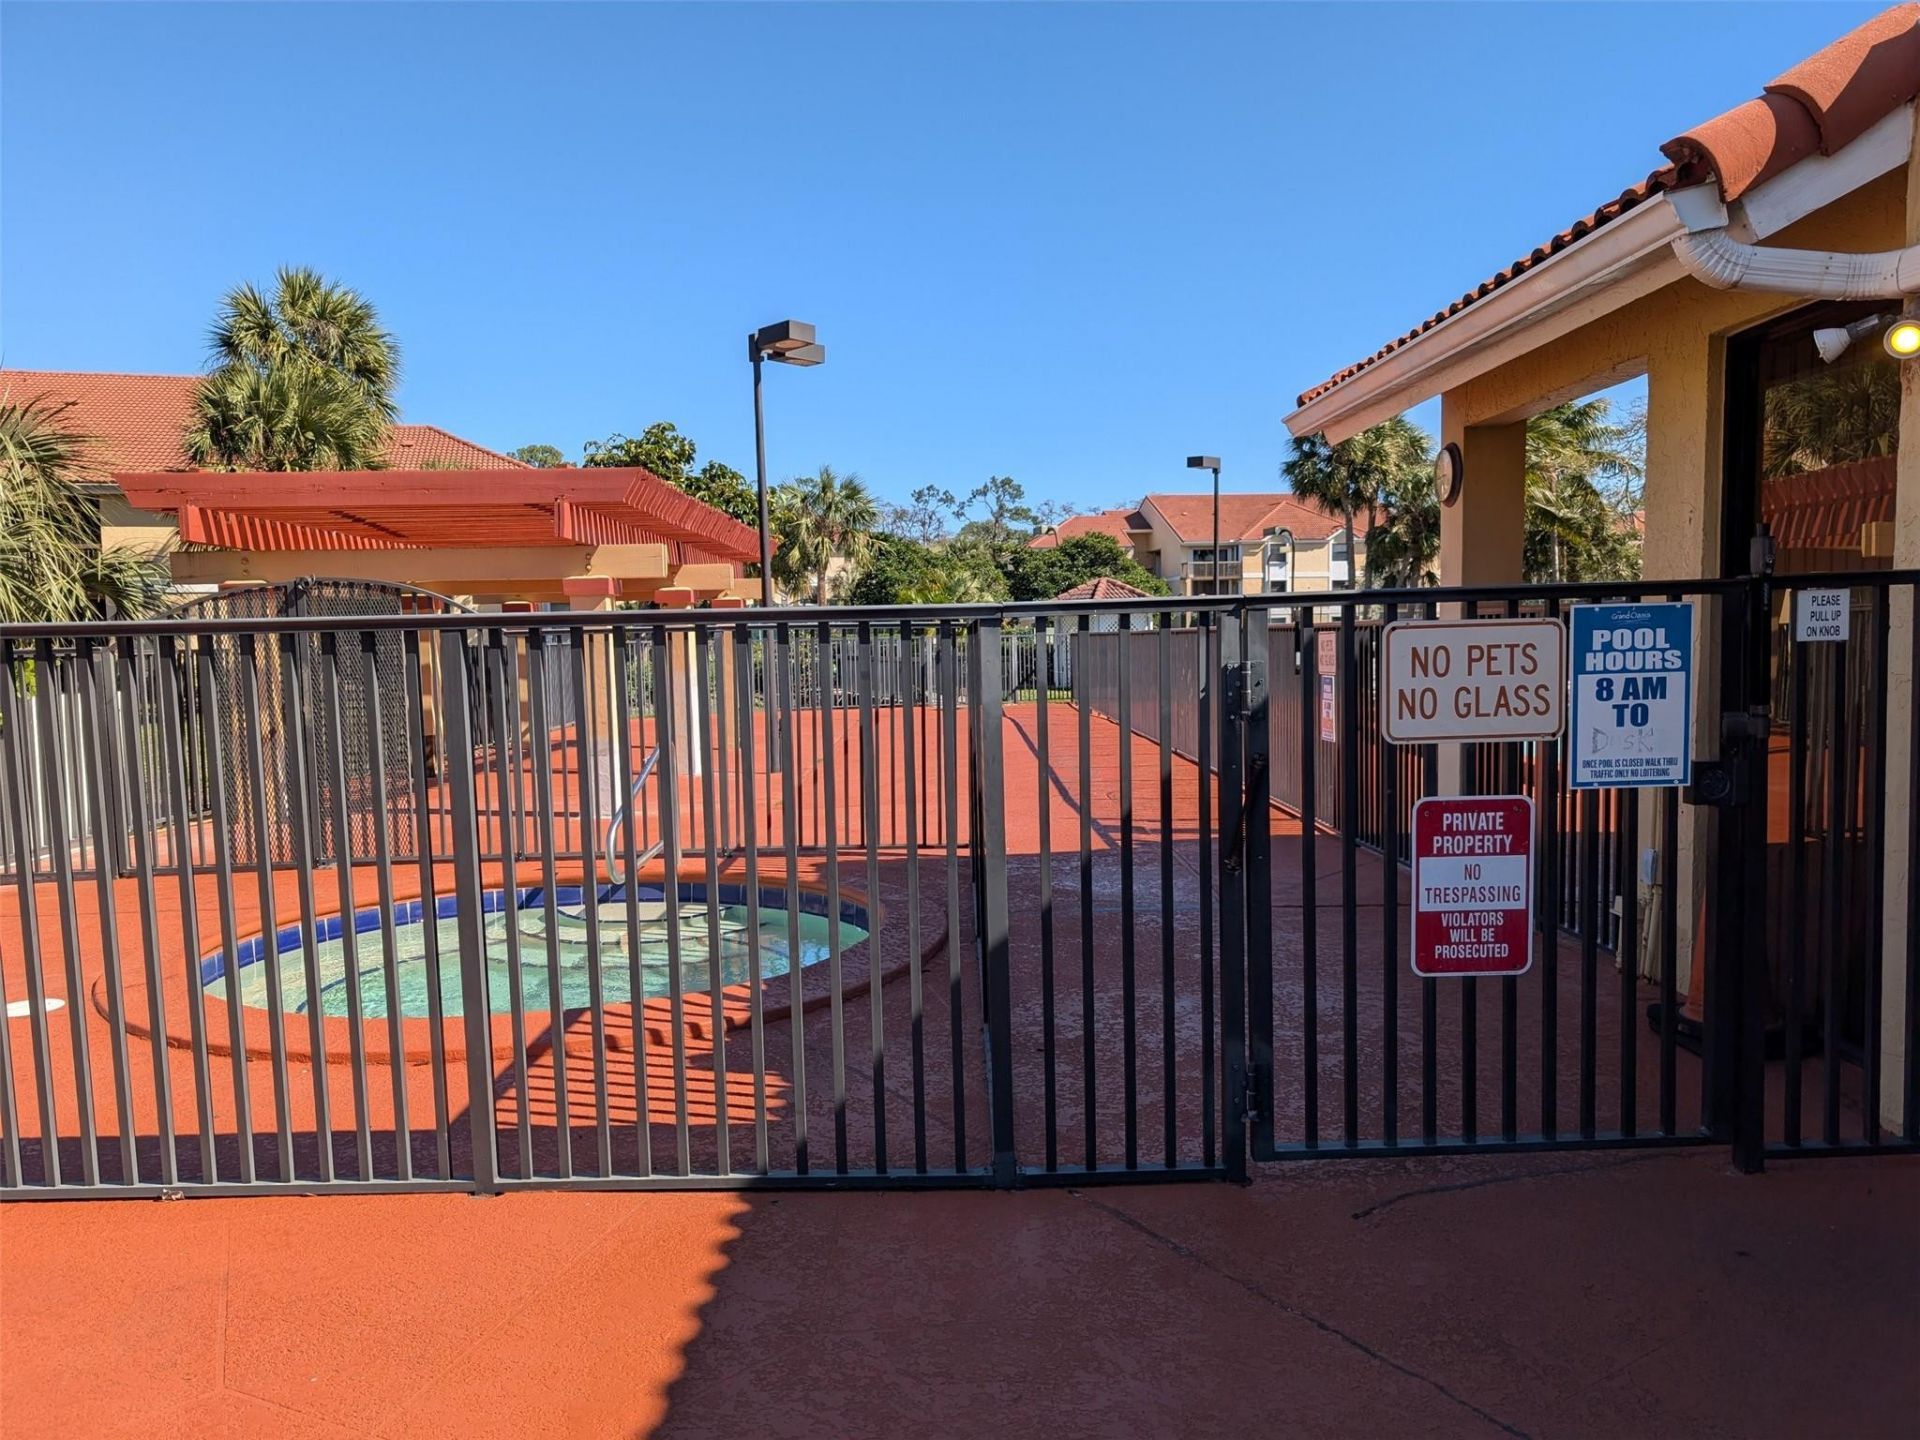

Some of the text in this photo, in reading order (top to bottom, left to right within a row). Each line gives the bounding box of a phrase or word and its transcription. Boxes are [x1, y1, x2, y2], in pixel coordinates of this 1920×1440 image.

[1812, 595, 1841, 606] PLEASE
[1810, 611, 1841, 622] PULL UP
[1592, 628, 1670, 650] POOL
[1806, 626, 1841, 637] ON KNOB
[1411, 642, 1538, 678] NO PETS
[1585, 650, 1682, 672] HOURS
[1595, 676, 1667, 702] 8 AM
[1398, 683, 1551, 720] NO GLASS
[1612, 703, 1649, 727] TO
[1582, 759, 1598, 768] ONCE
[1598, 759, 1613, 768] POOL
[1615, 759, 1621, 767] IS
[1622, 758, 1644, 767] CLOSED
[1645, 758, 1661, 766] WALK
[1590, 768, 1670, 778] TRAFFIC ONLY NO LOITERING
[1443, 812, 1504, 831] PRIVATE
[1433, 834, 1513, 854] PROPERTY
[1464, 863, 1481, 881] NO
[1425, 885, 1521, 904] TRESPASSING
[1441, 912, 1504, 927] VIOLATORS
[1450, 928, 1495, 942] WILL BE
[1435, 944, 1509, 959] PROSECUTED
